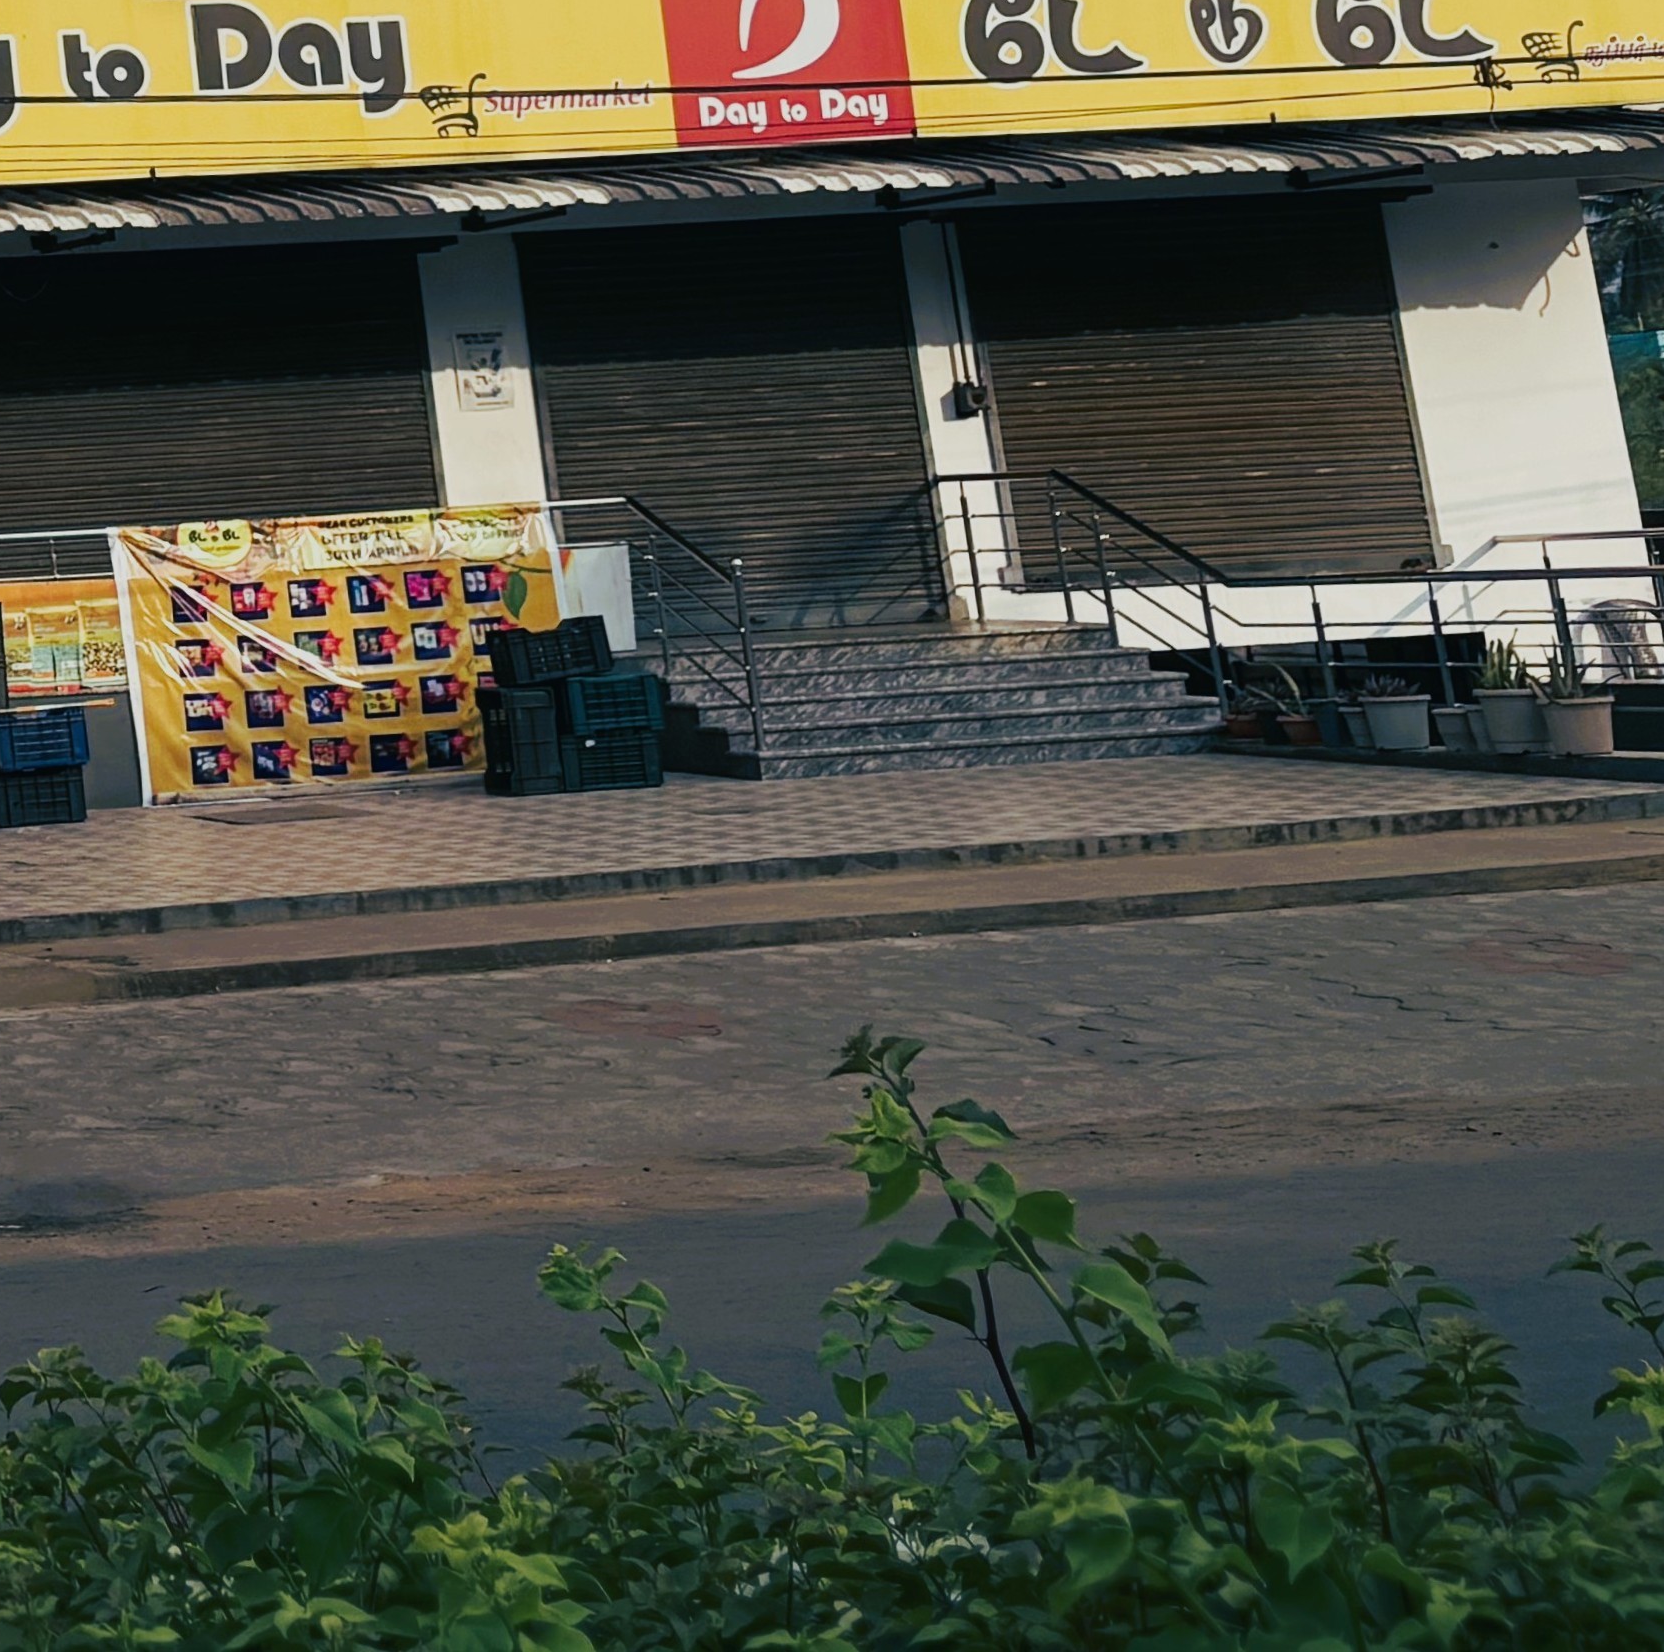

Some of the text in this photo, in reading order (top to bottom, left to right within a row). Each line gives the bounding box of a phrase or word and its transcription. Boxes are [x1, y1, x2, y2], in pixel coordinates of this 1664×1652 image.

[61, 33, 147, 99] to
[187, 2, 407, 115] Day
[484, 82, 652, 119] Supermarket
[698, 88, 889, 134] Day to Day
